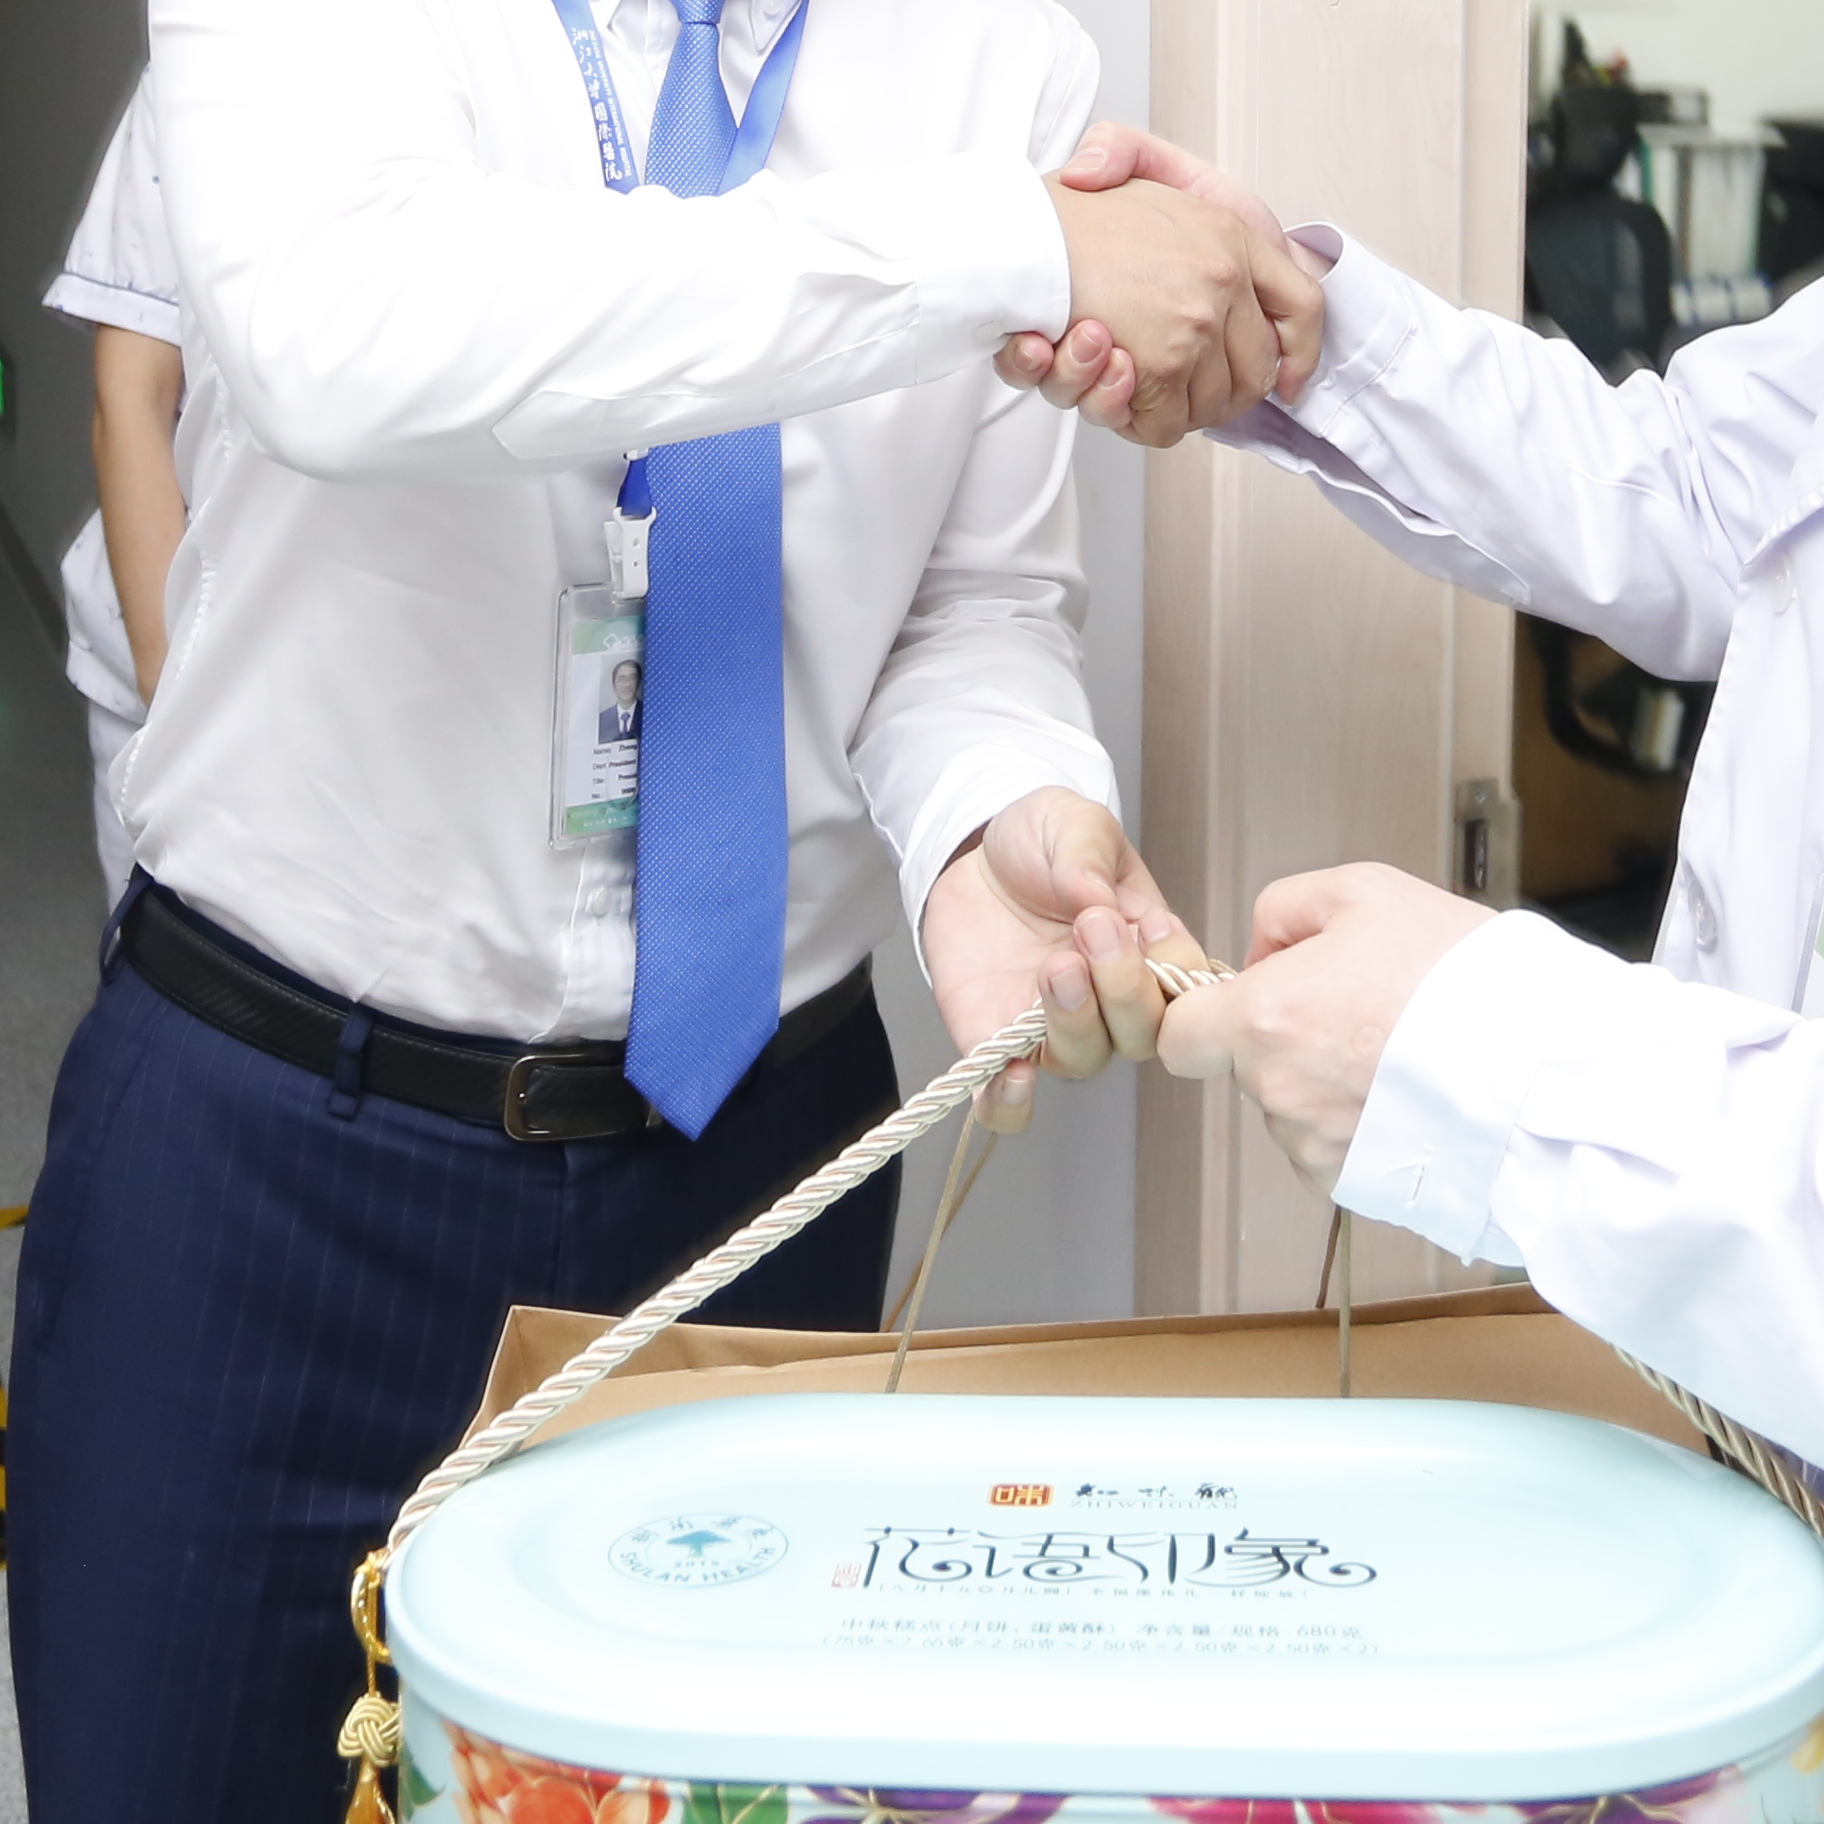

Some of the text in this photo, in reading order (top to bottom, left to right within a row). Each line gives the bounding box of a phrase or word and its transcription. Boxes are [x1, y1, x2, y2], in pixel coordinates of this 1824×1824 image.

[620, 1547, 776, 1582] SHULAN HEALTH
[863, 1526, 1377, 1589] 花语印象
